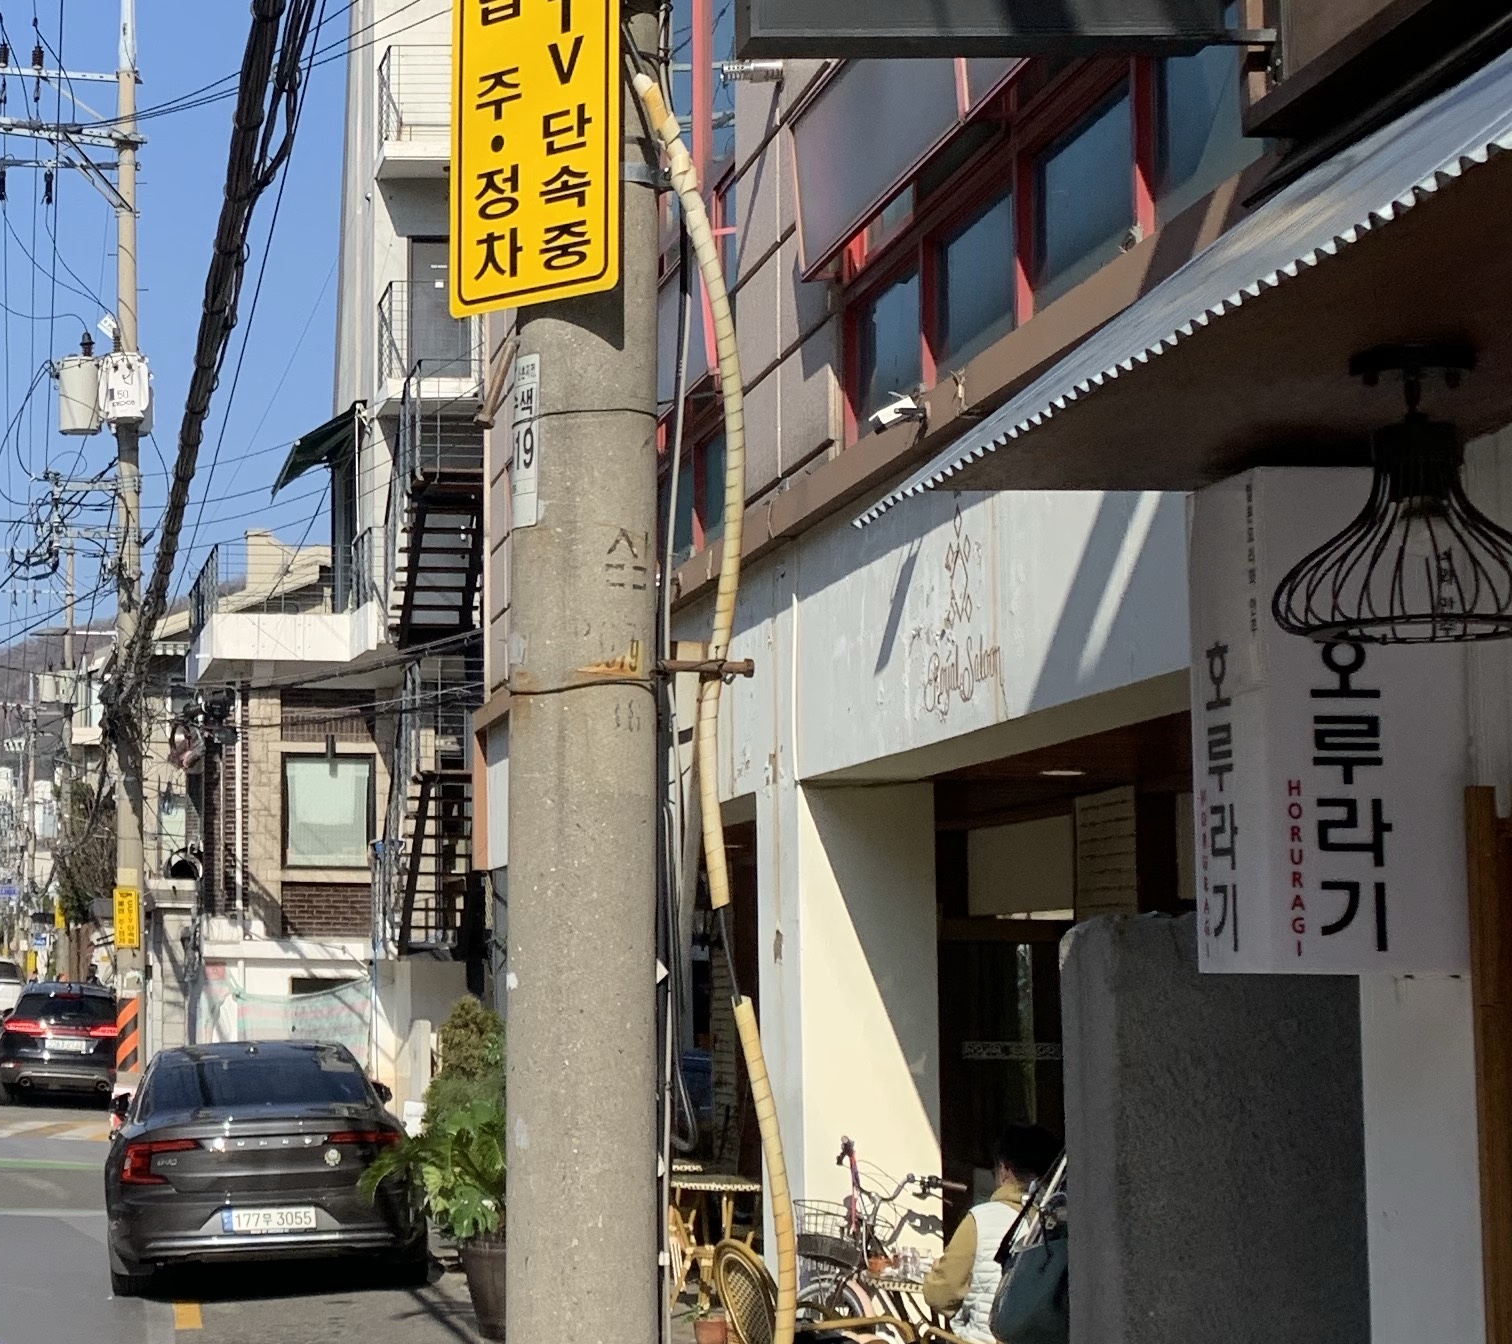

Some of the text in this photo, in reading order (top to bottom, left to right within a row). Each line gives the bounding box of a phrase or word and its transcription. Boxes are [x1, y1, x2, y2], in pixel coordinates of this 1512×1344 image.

[514, 387, 533, 415] 색
[1206, 641, 1239, 953] 호루라기
[1287, 778, 1307, 958] HORURAGI
